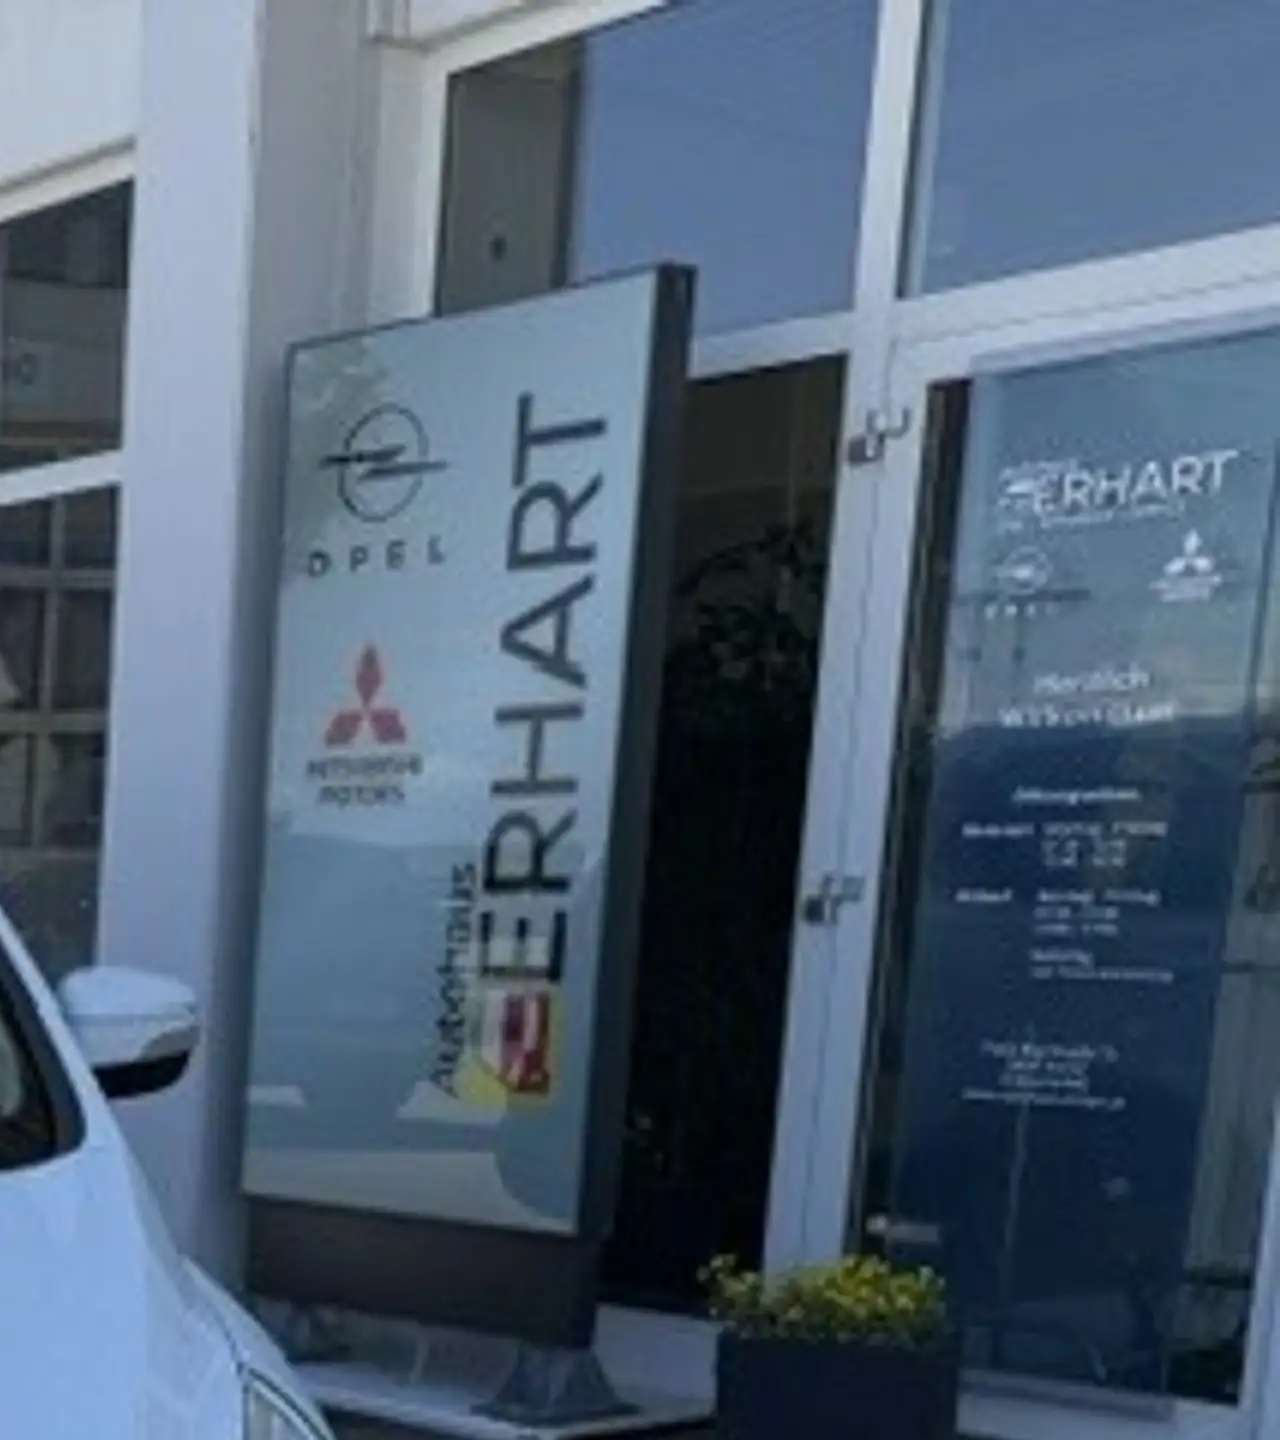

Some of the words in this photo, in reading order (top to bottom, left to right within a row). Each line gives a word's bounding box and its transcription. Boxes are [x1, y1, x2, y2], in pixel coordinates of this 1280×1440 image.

[307, 535, 447, 578] OPEL
[1032, 449, 1239, 518] ERHART
[480, 389, 609, 984] ERHART
[428, 862, 478, 1099] Autohaus
